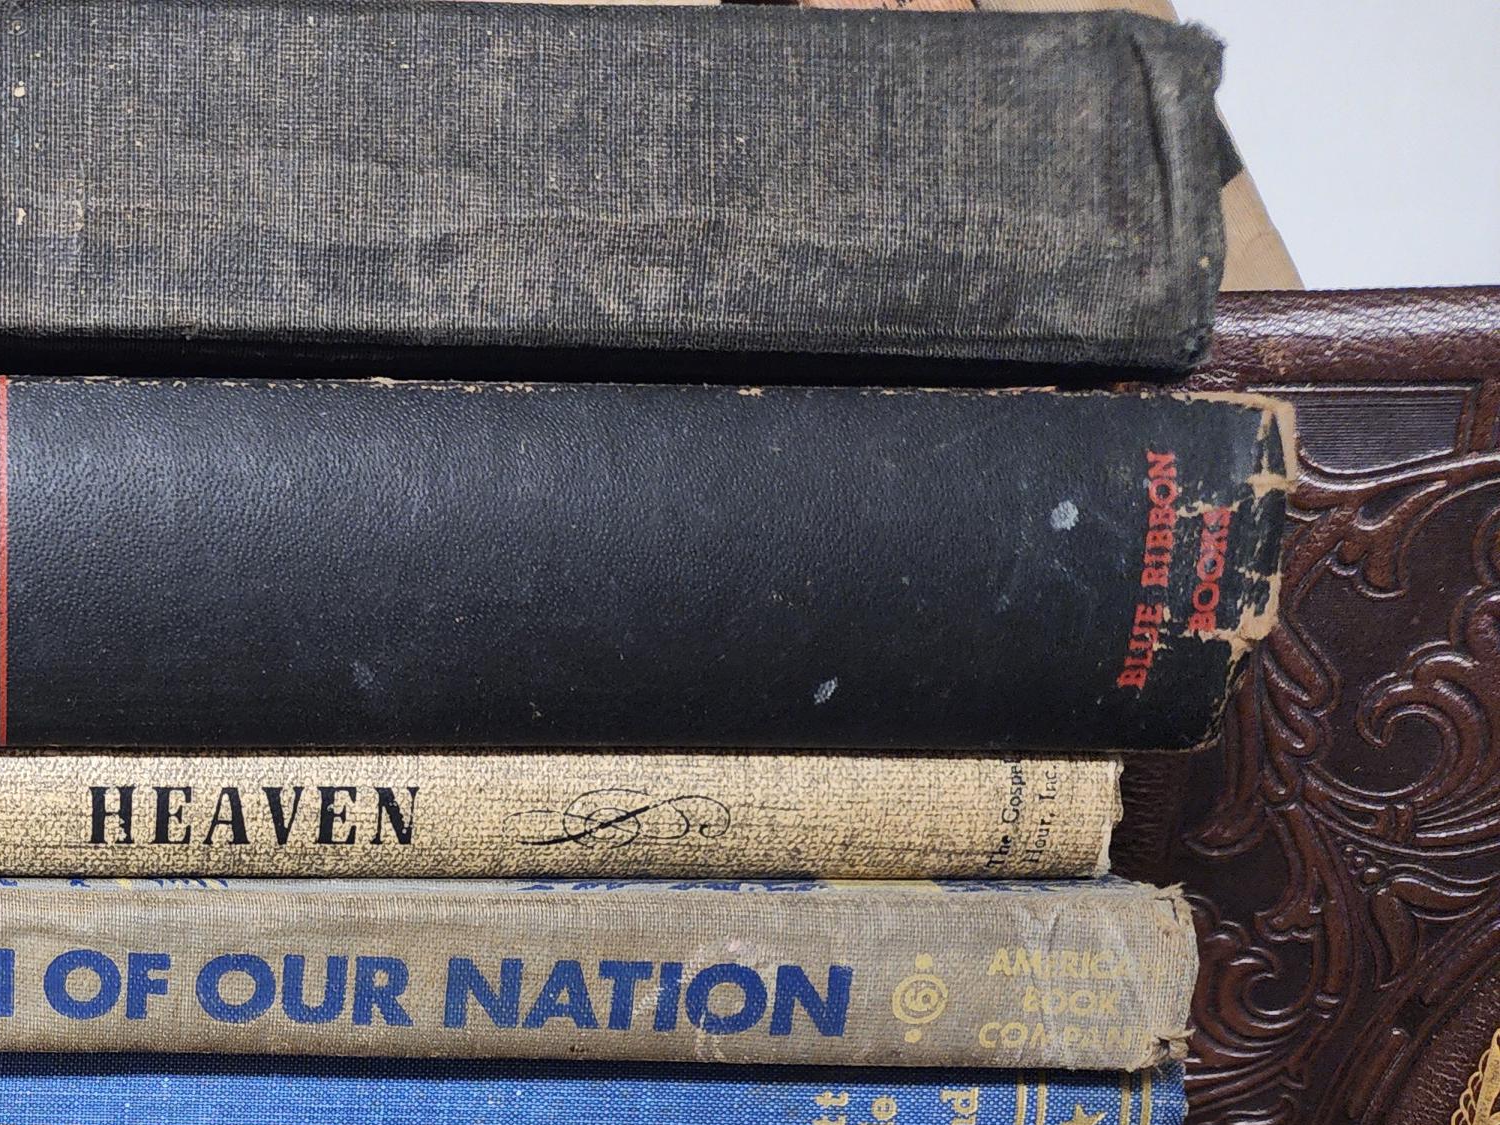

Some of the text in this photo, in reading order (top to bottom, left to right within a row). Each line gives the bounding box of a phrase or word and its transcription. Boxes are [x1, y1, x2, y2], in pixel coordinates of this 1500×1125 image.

[1115, 449, 1179, 689] BLUE RIBBON
[88, 785, 421, 847] HEAVEN
[983, 758, 1027, 868] The Gospel
[1038, 763, 1059, 801] Inc.
[42, 947, 172, 1021] OF
[194, 952, 415, 1029] OUR
[442, 956, 854, 1038] NATION
